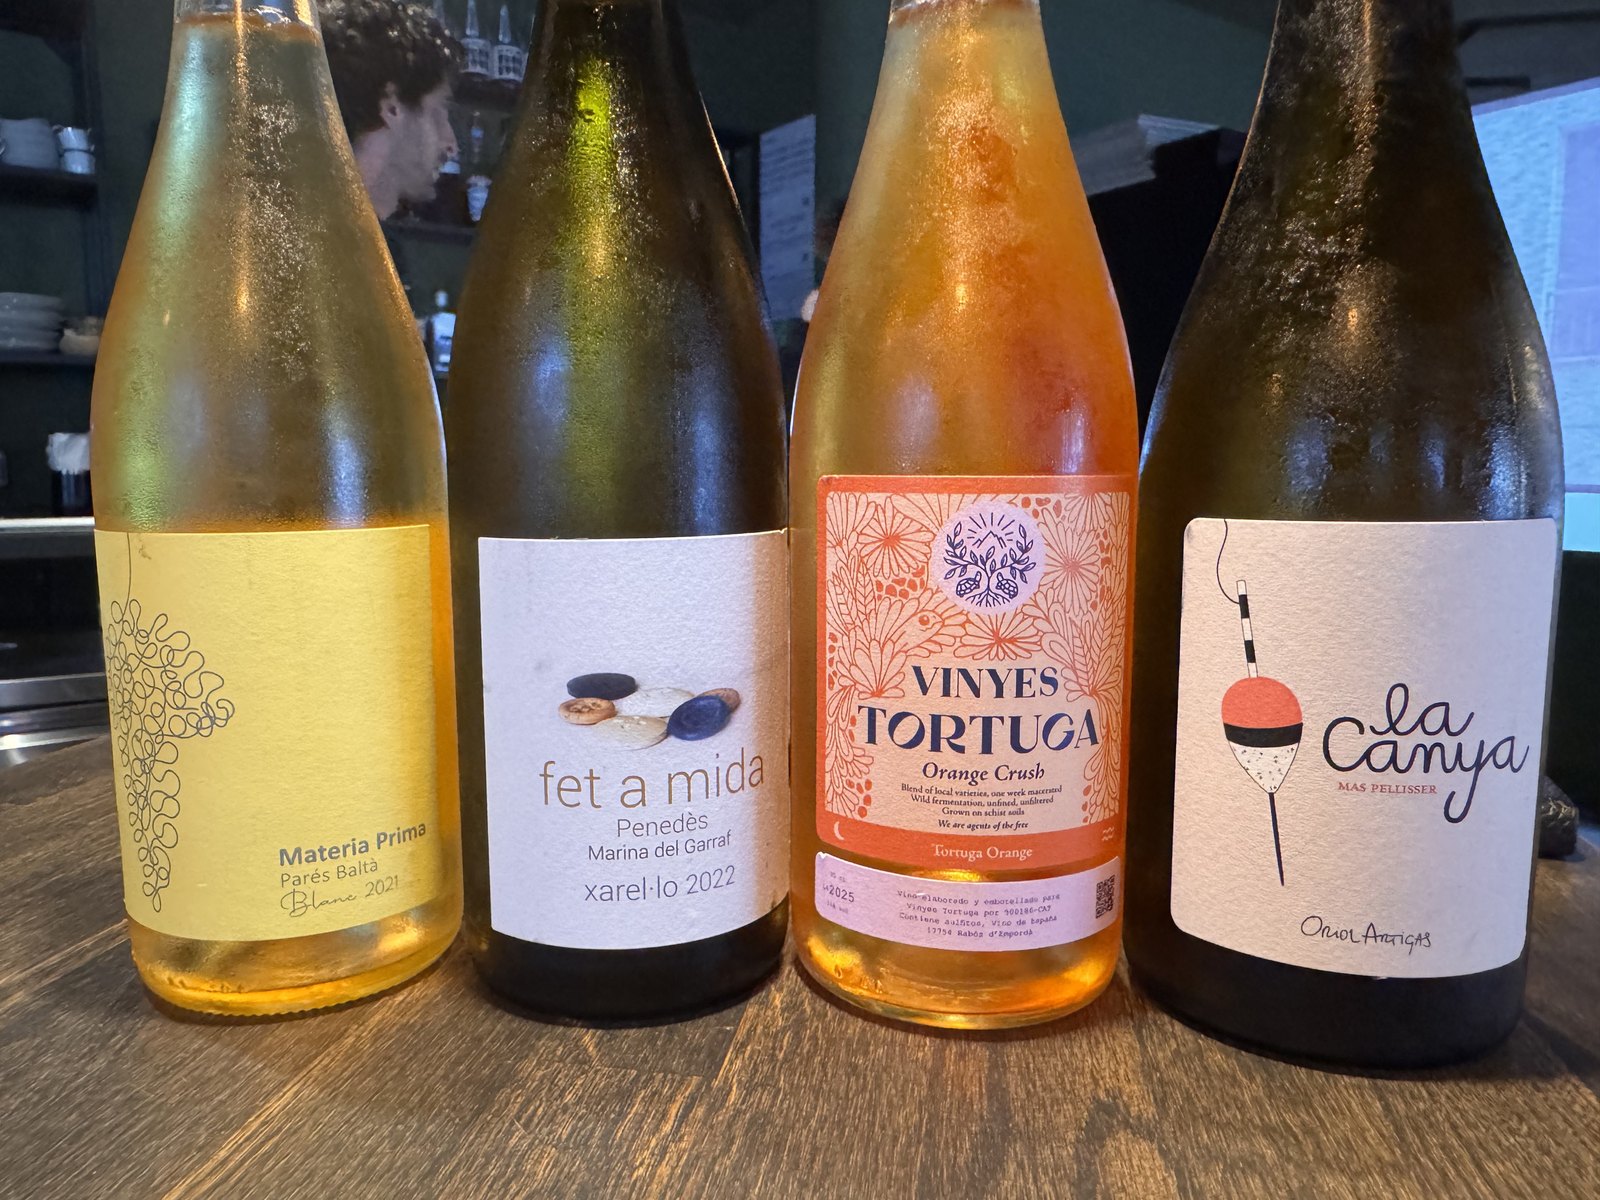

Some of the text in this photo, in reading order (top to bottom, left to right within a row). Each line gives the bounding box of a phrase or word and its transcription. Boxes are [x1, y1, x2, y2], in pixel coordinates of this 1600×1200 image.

[912, 666, 1059, 698] VINYES
[1369, 683, 1475, 736] la
[858, 705, 1100, 755] TORTUGA
[539, 747, 764, 809] fet a mida
[922, 761, 1045, 786] Orange Crush
[1322, 716, 1530, 823] Canya
[901, 783, 1062, 798] Blend of local varieties, one week macerated
[910, 794, 931, 804] Wild
[932, 796, 985, 807] fermentation,
[1020, 795, 1054, 806] unfiltered
[1338, 781, 1438, 794] MAS PELLISSER
[617, 811, 708, 837] Penedès
[938, 819, 951, 828] We
[967, 822, 991, 831] agents
[993, 820, 1001, 831] of
[1002, 820, 1013, 829] the
[1013, 820, 1029, 831] free
[941, 807, 1025, 817] Grown on schist soils
[279, 823, 426, 866] Materia Prima
[588, 829, 732, 860] Marina del Garraf
[933, 844, 1033, 861] Tortuga Orange
[281, 858, 378, 888] Parés Baltà
[584, 865, 735, 902] xarel·lo 2022
[280, 875, 399, 918] Blanc 2021
[942, 908, 979, 918] Tortuga
[984, 910, 1000, 918] por
